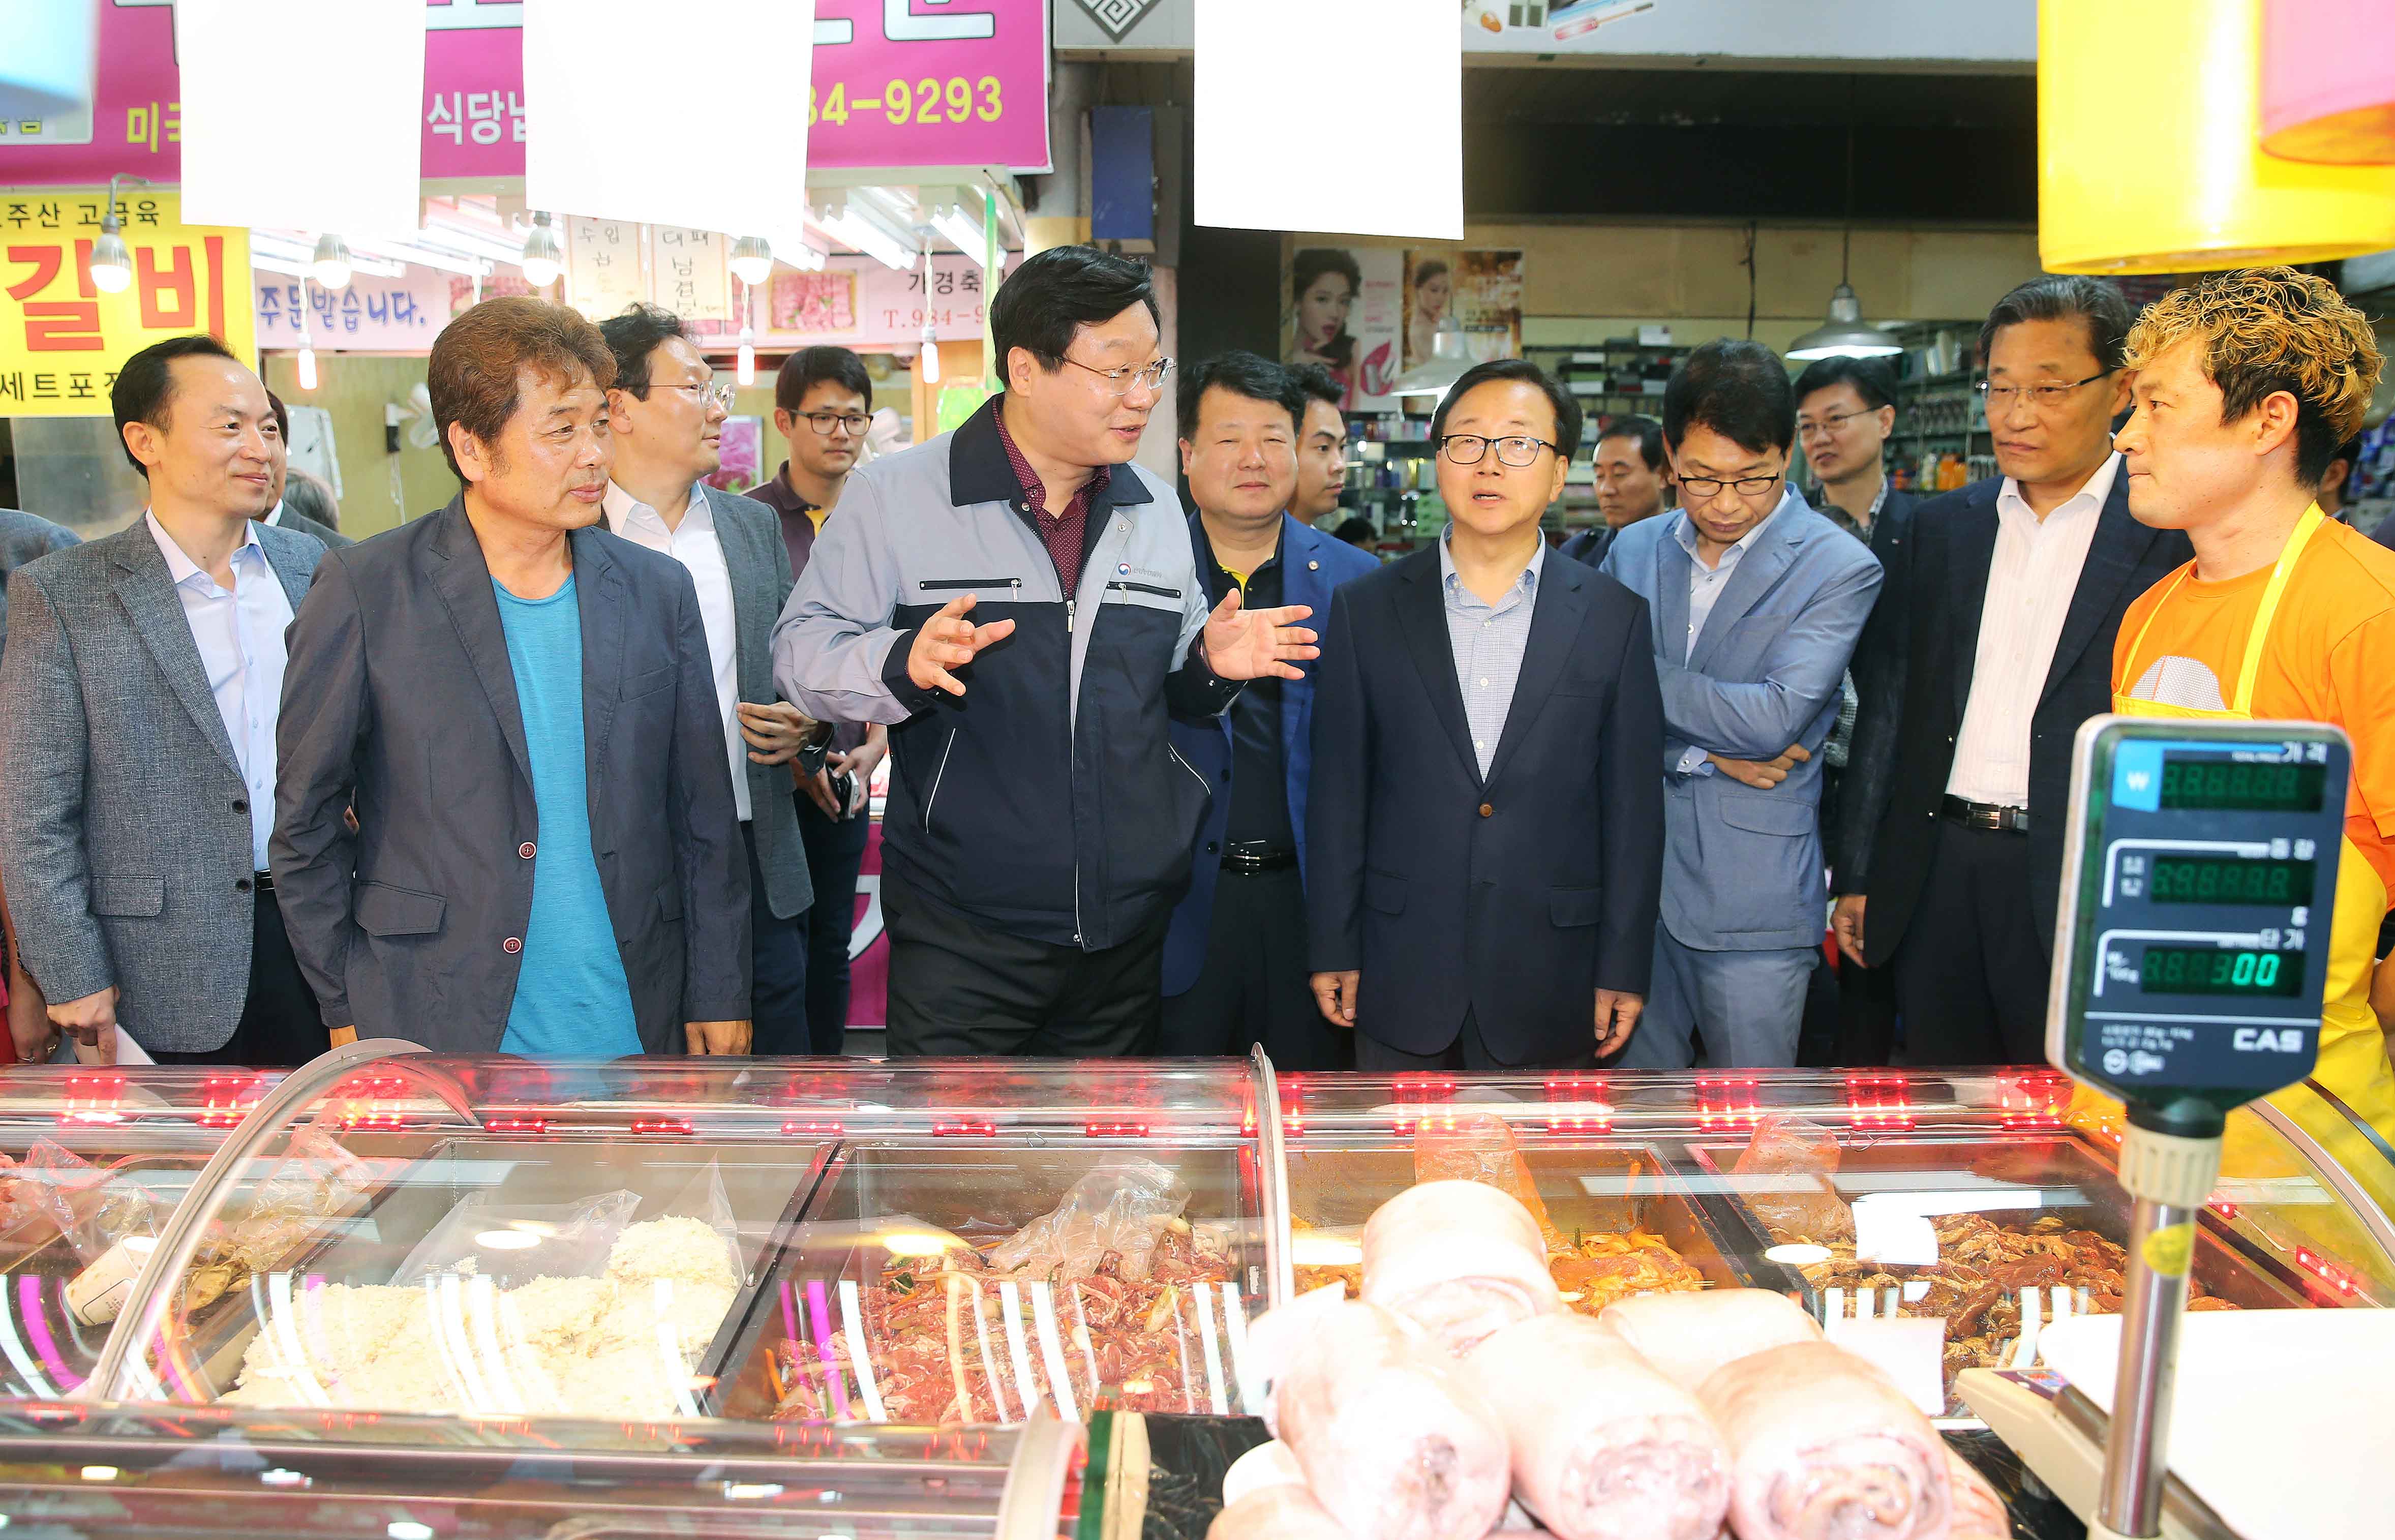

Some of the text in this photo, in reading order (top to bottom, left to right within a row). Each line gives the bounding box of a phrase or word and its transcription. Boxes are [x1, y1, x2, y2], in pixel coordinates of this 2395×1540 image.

[0, 202, 60, 229] 주산
[6, 236, 227, 351] 갈비
[260, 285, 426, 331] 주문받습니다.
[2233, 1029, 2304, 1053] CAS
